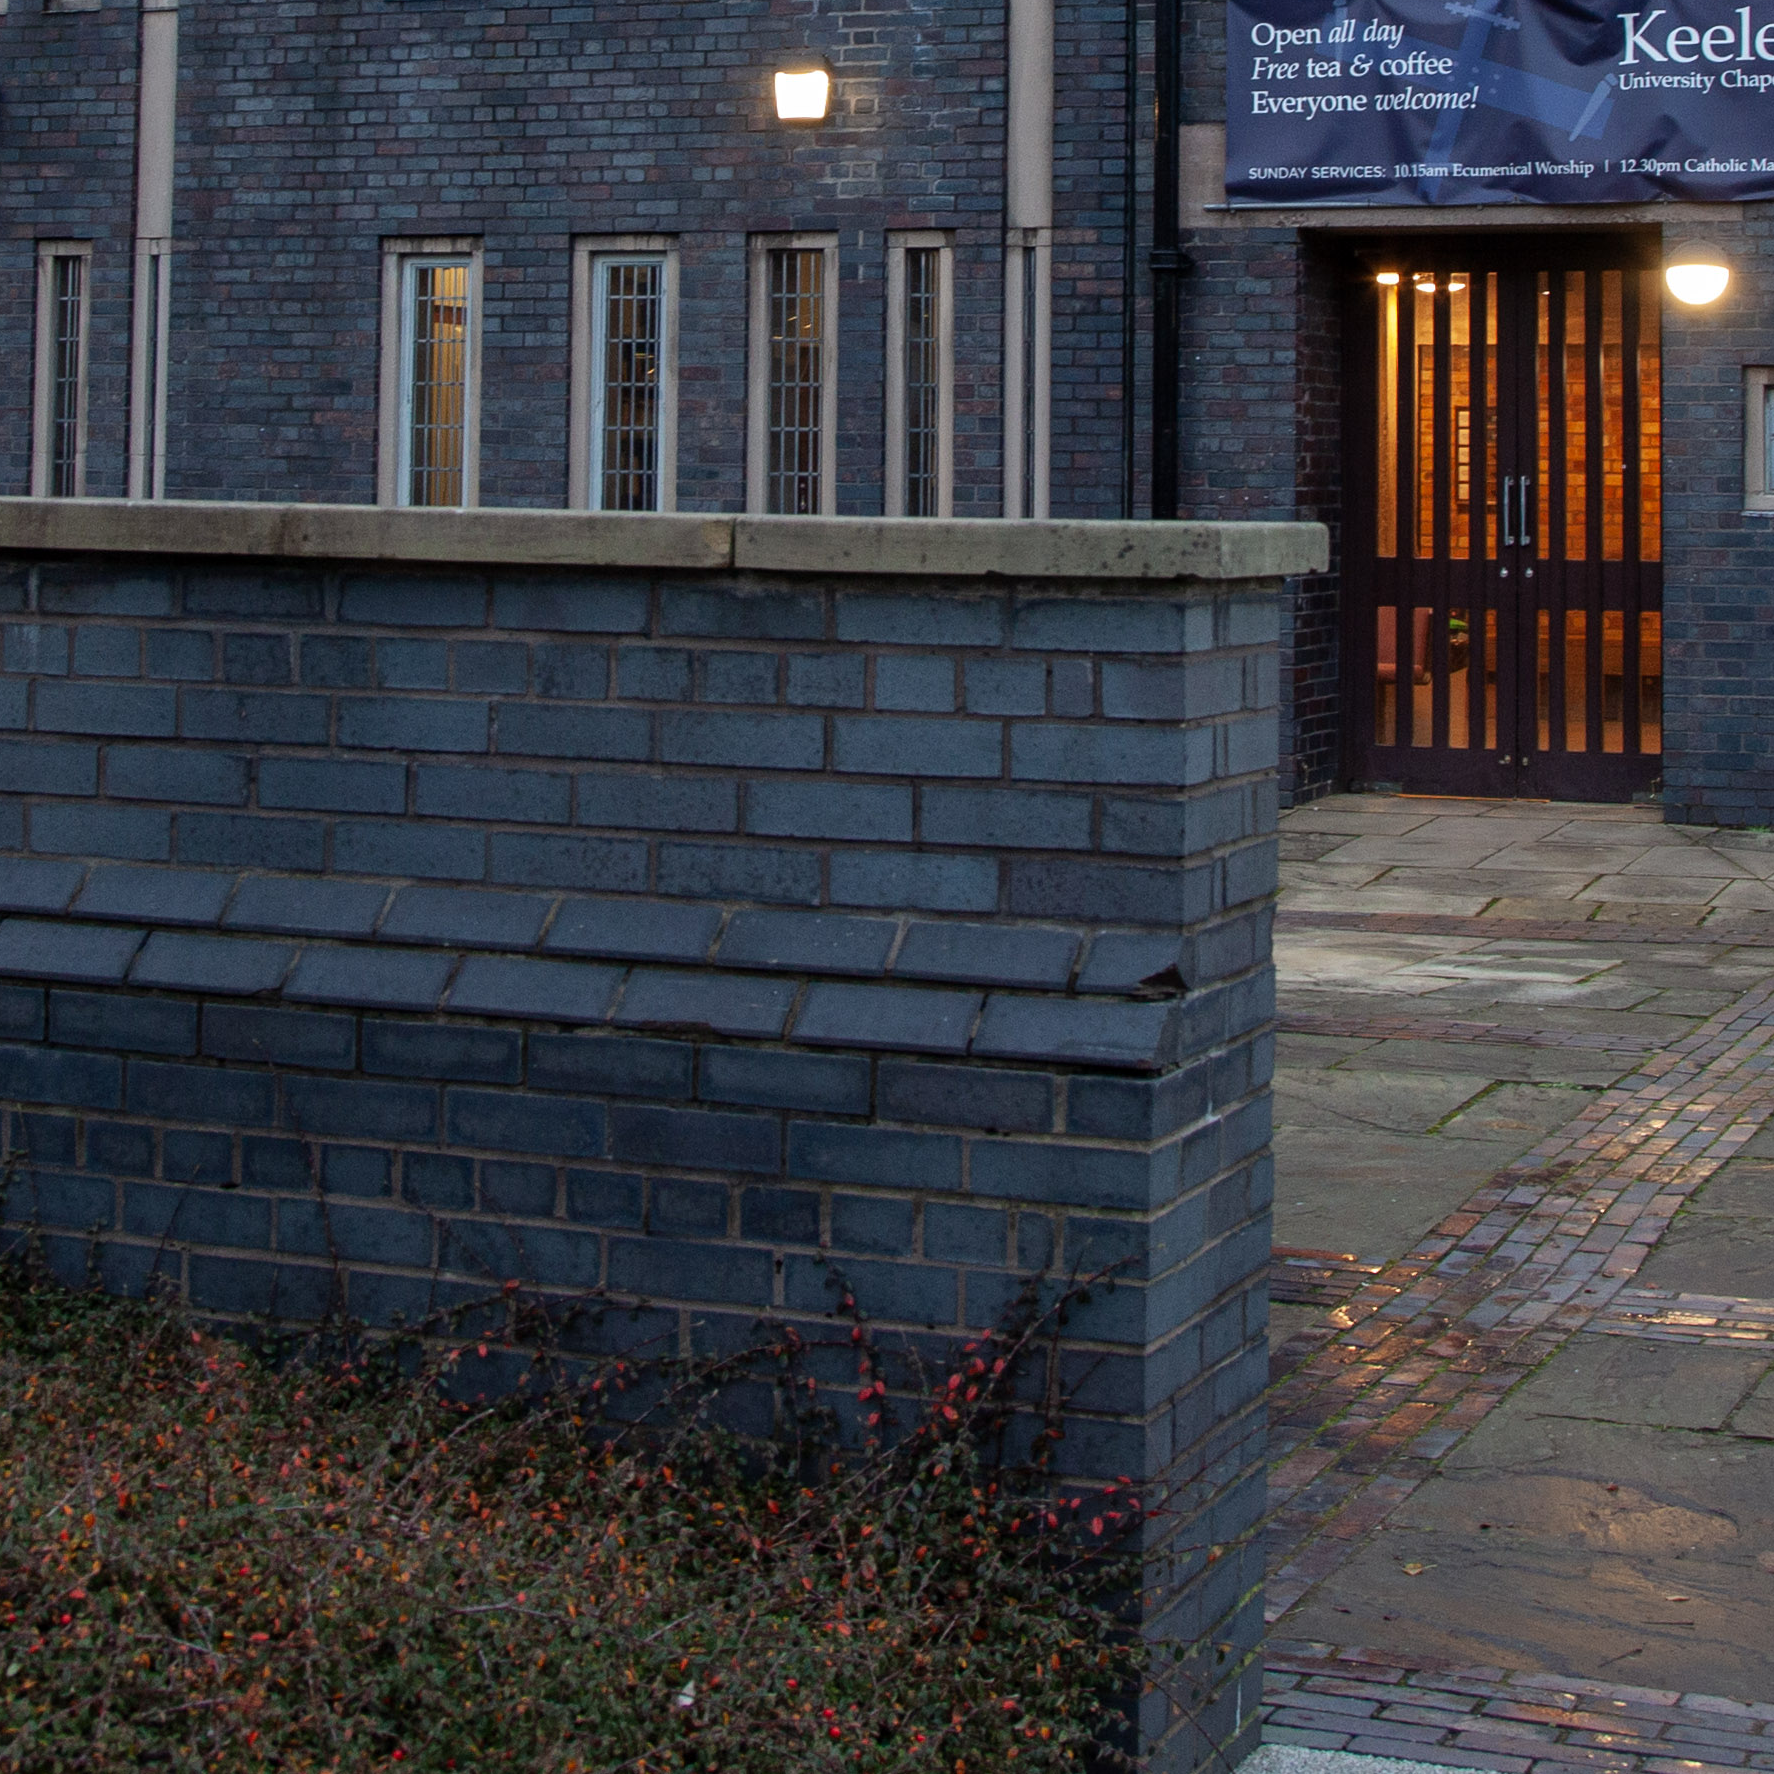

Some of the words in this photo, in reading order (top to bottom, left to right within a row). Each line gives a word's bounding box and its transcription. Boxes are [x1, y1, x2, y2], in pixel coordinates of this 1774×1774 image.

[1251, 22, 1323, 54] Open
[1327, 18, 1356, 44] all
[1362, 18, 1405, 49] day
[1250, 56, 1300, 80] Free
[1306, 58, 1342, 78] tea
[1349, 53, 1374, 77] &
[1379, 51, 1453, 76] coffee
[1618, 71, 1716, 94] University
[1250, 90, 1368, 121] Everyone
[1374, 85, 1480, 111] welcome!
[1248, 166, 1308, 180] SUNDAY
[1310, 165, 1387, 179] SERVICES:
[1393, 163, 1449, 178] 10.15am
[1451, 161, 1533, 177] Ecumenical
[1534, 160, 1595, 178] Worship
[1620, 158, 1681, 176] 12.30pm
[1683, 157, 1749, 173] Catholic
